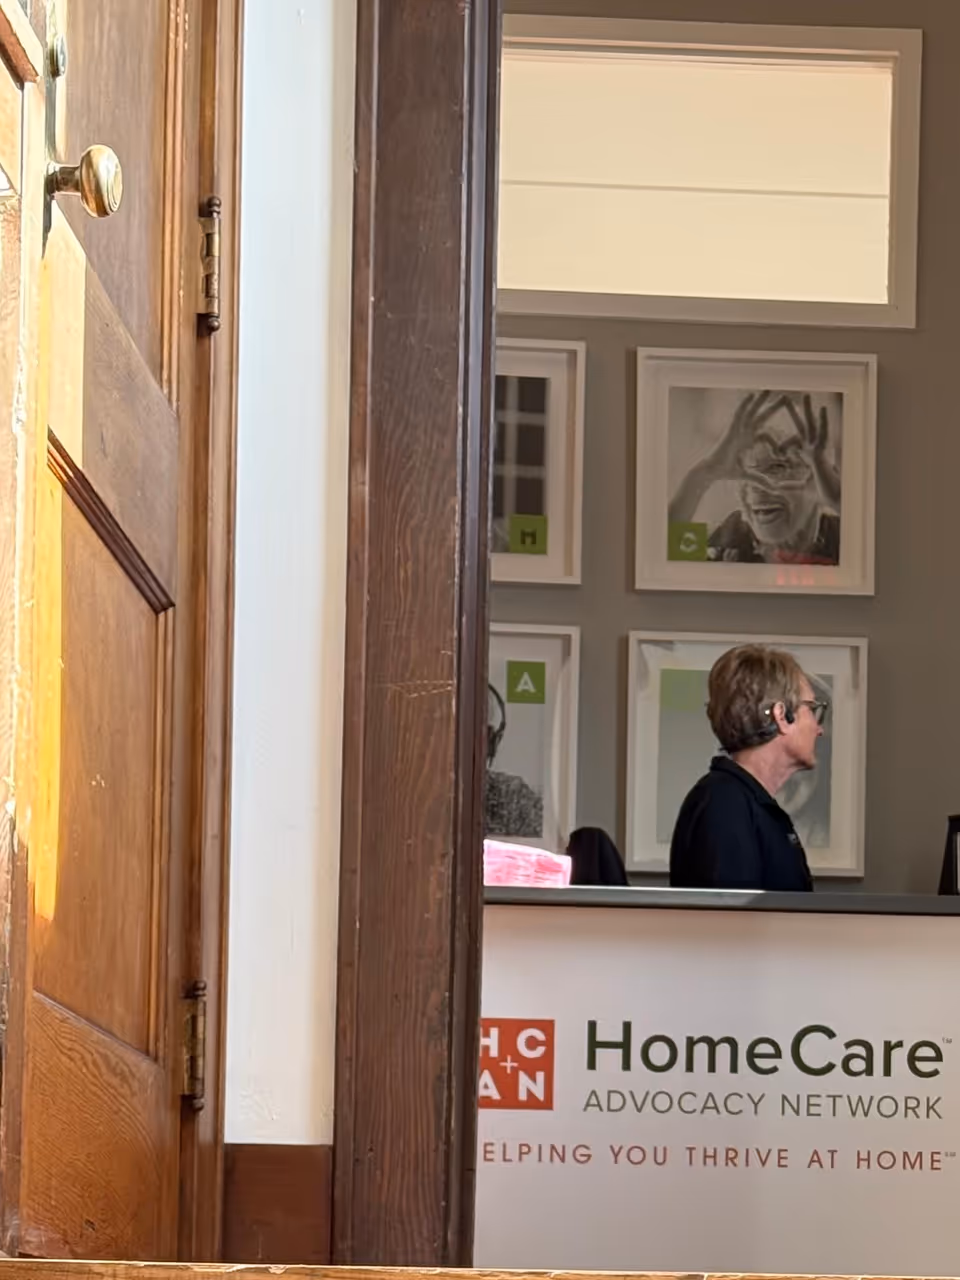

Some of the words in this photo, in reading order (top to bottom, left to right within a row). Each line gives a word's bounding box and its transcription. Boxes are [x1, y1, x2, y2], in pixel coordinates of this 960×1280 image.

[515, 671, 537, 693] A
[586, 1019, 943, 1079] HomeCare
[583, 1089, 766, 1117] ADVOCACY
[781, 1093, 943, 1120] NETWORK
[482, 1142, 593, 1165] ELPING
[609, 1144, 668, 1167] YOU
[685, 1146, 789, 1169] THRIVE
[806, 1148, 838, 1170] AT
[856, 1150, 942, 1171] HOME
